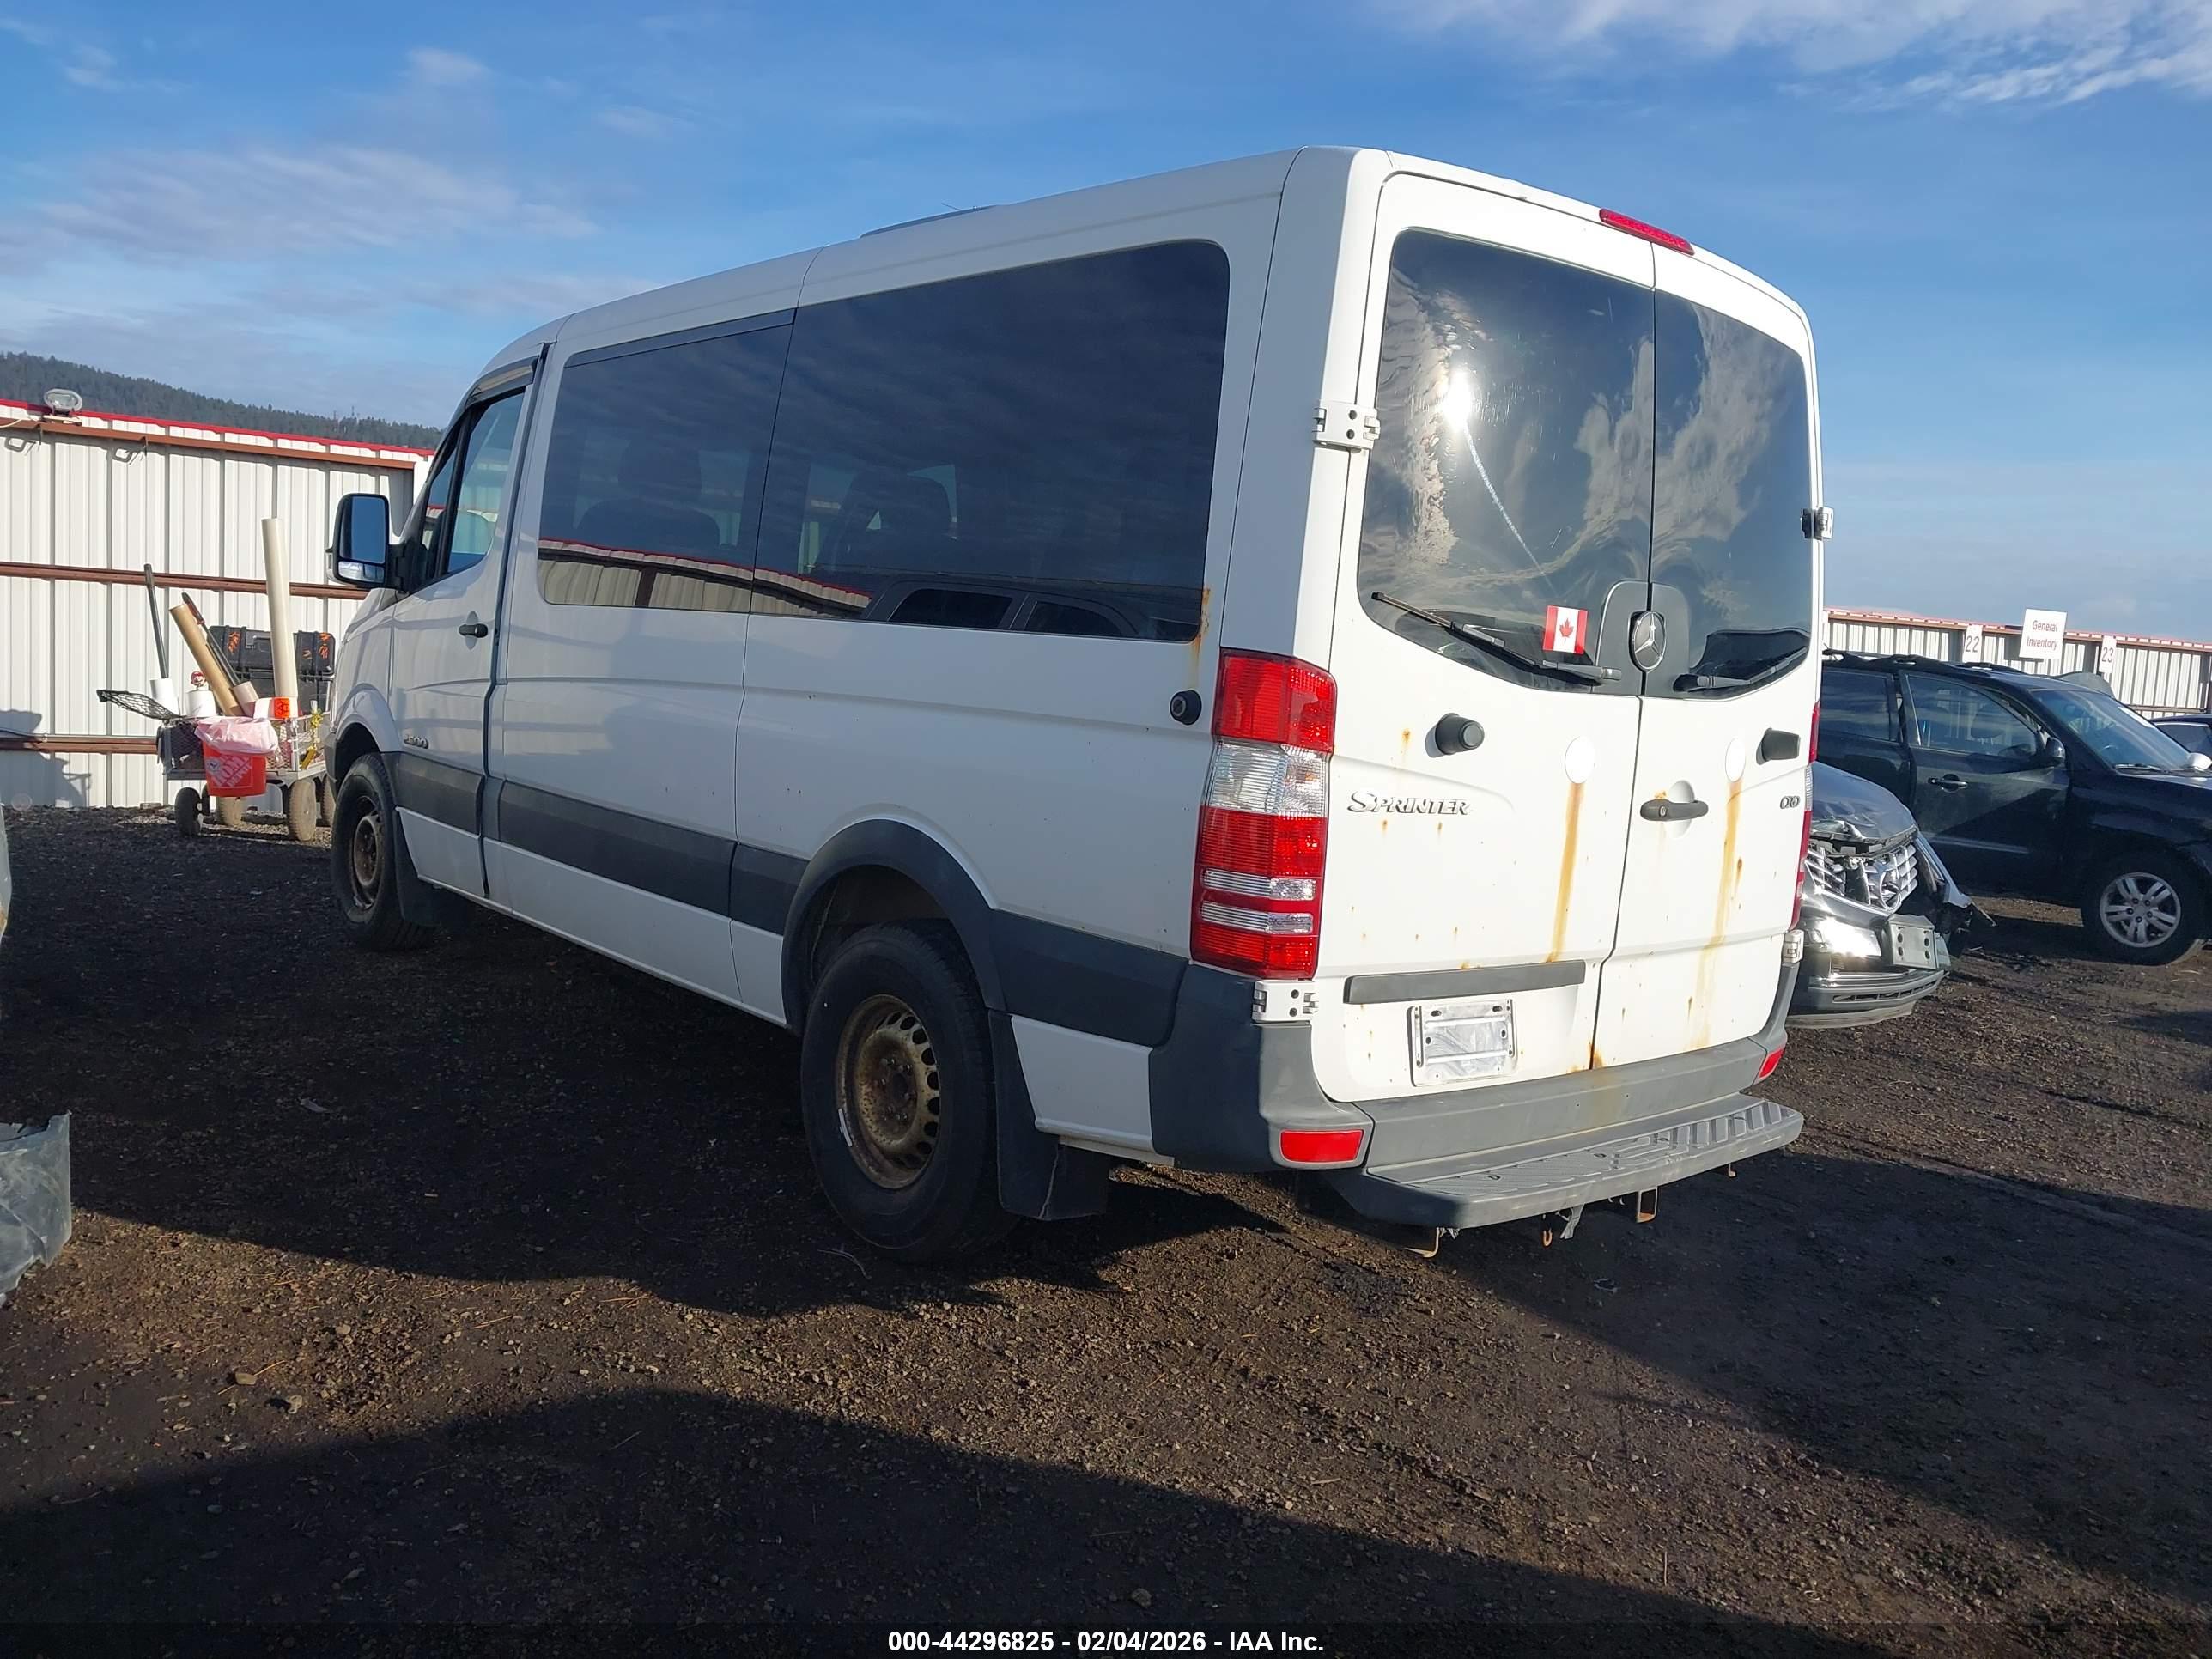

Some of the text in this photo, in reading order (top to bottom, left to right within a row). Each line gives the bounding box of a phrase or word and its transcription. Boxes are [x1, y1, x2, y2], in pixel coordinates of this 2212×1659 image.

[2032, 619, 2058, 632] General
[1965, 635, 1980, 653] 22
[2026, 635, 2058, 651] Inventory
[2101, 647, 2114, 663] 23
[1346, 790, 1470, 815] SPRINTER
